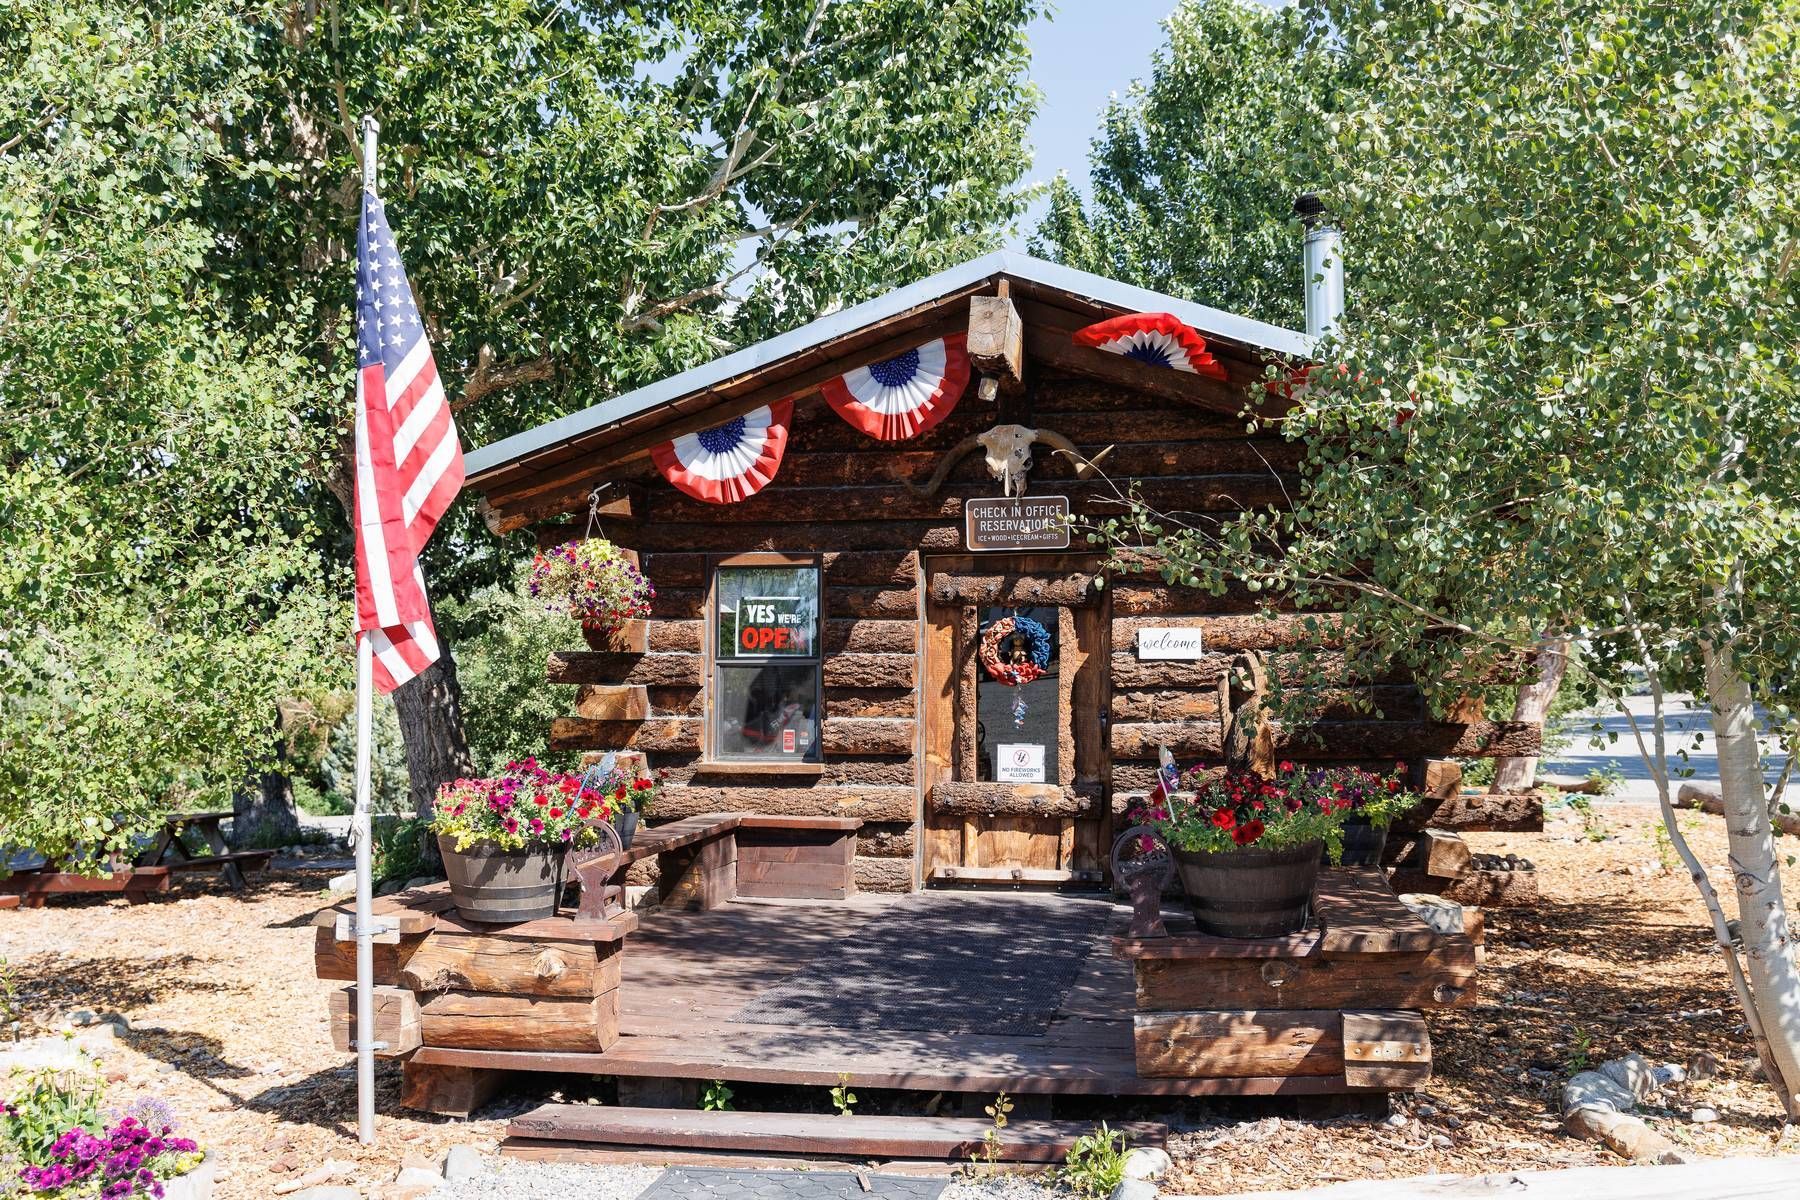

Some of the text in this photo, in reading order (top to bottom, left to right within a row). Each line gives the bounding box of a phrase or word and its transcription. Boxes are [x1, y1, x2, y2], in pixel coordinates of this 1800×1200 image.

[973, 505, 1062, 518] CHECK IN OFFICE
[747, 604, 775, 623] YES
[742, 626, 806, 649] OPEN
[1142, 632, 1198, 649] welcome
